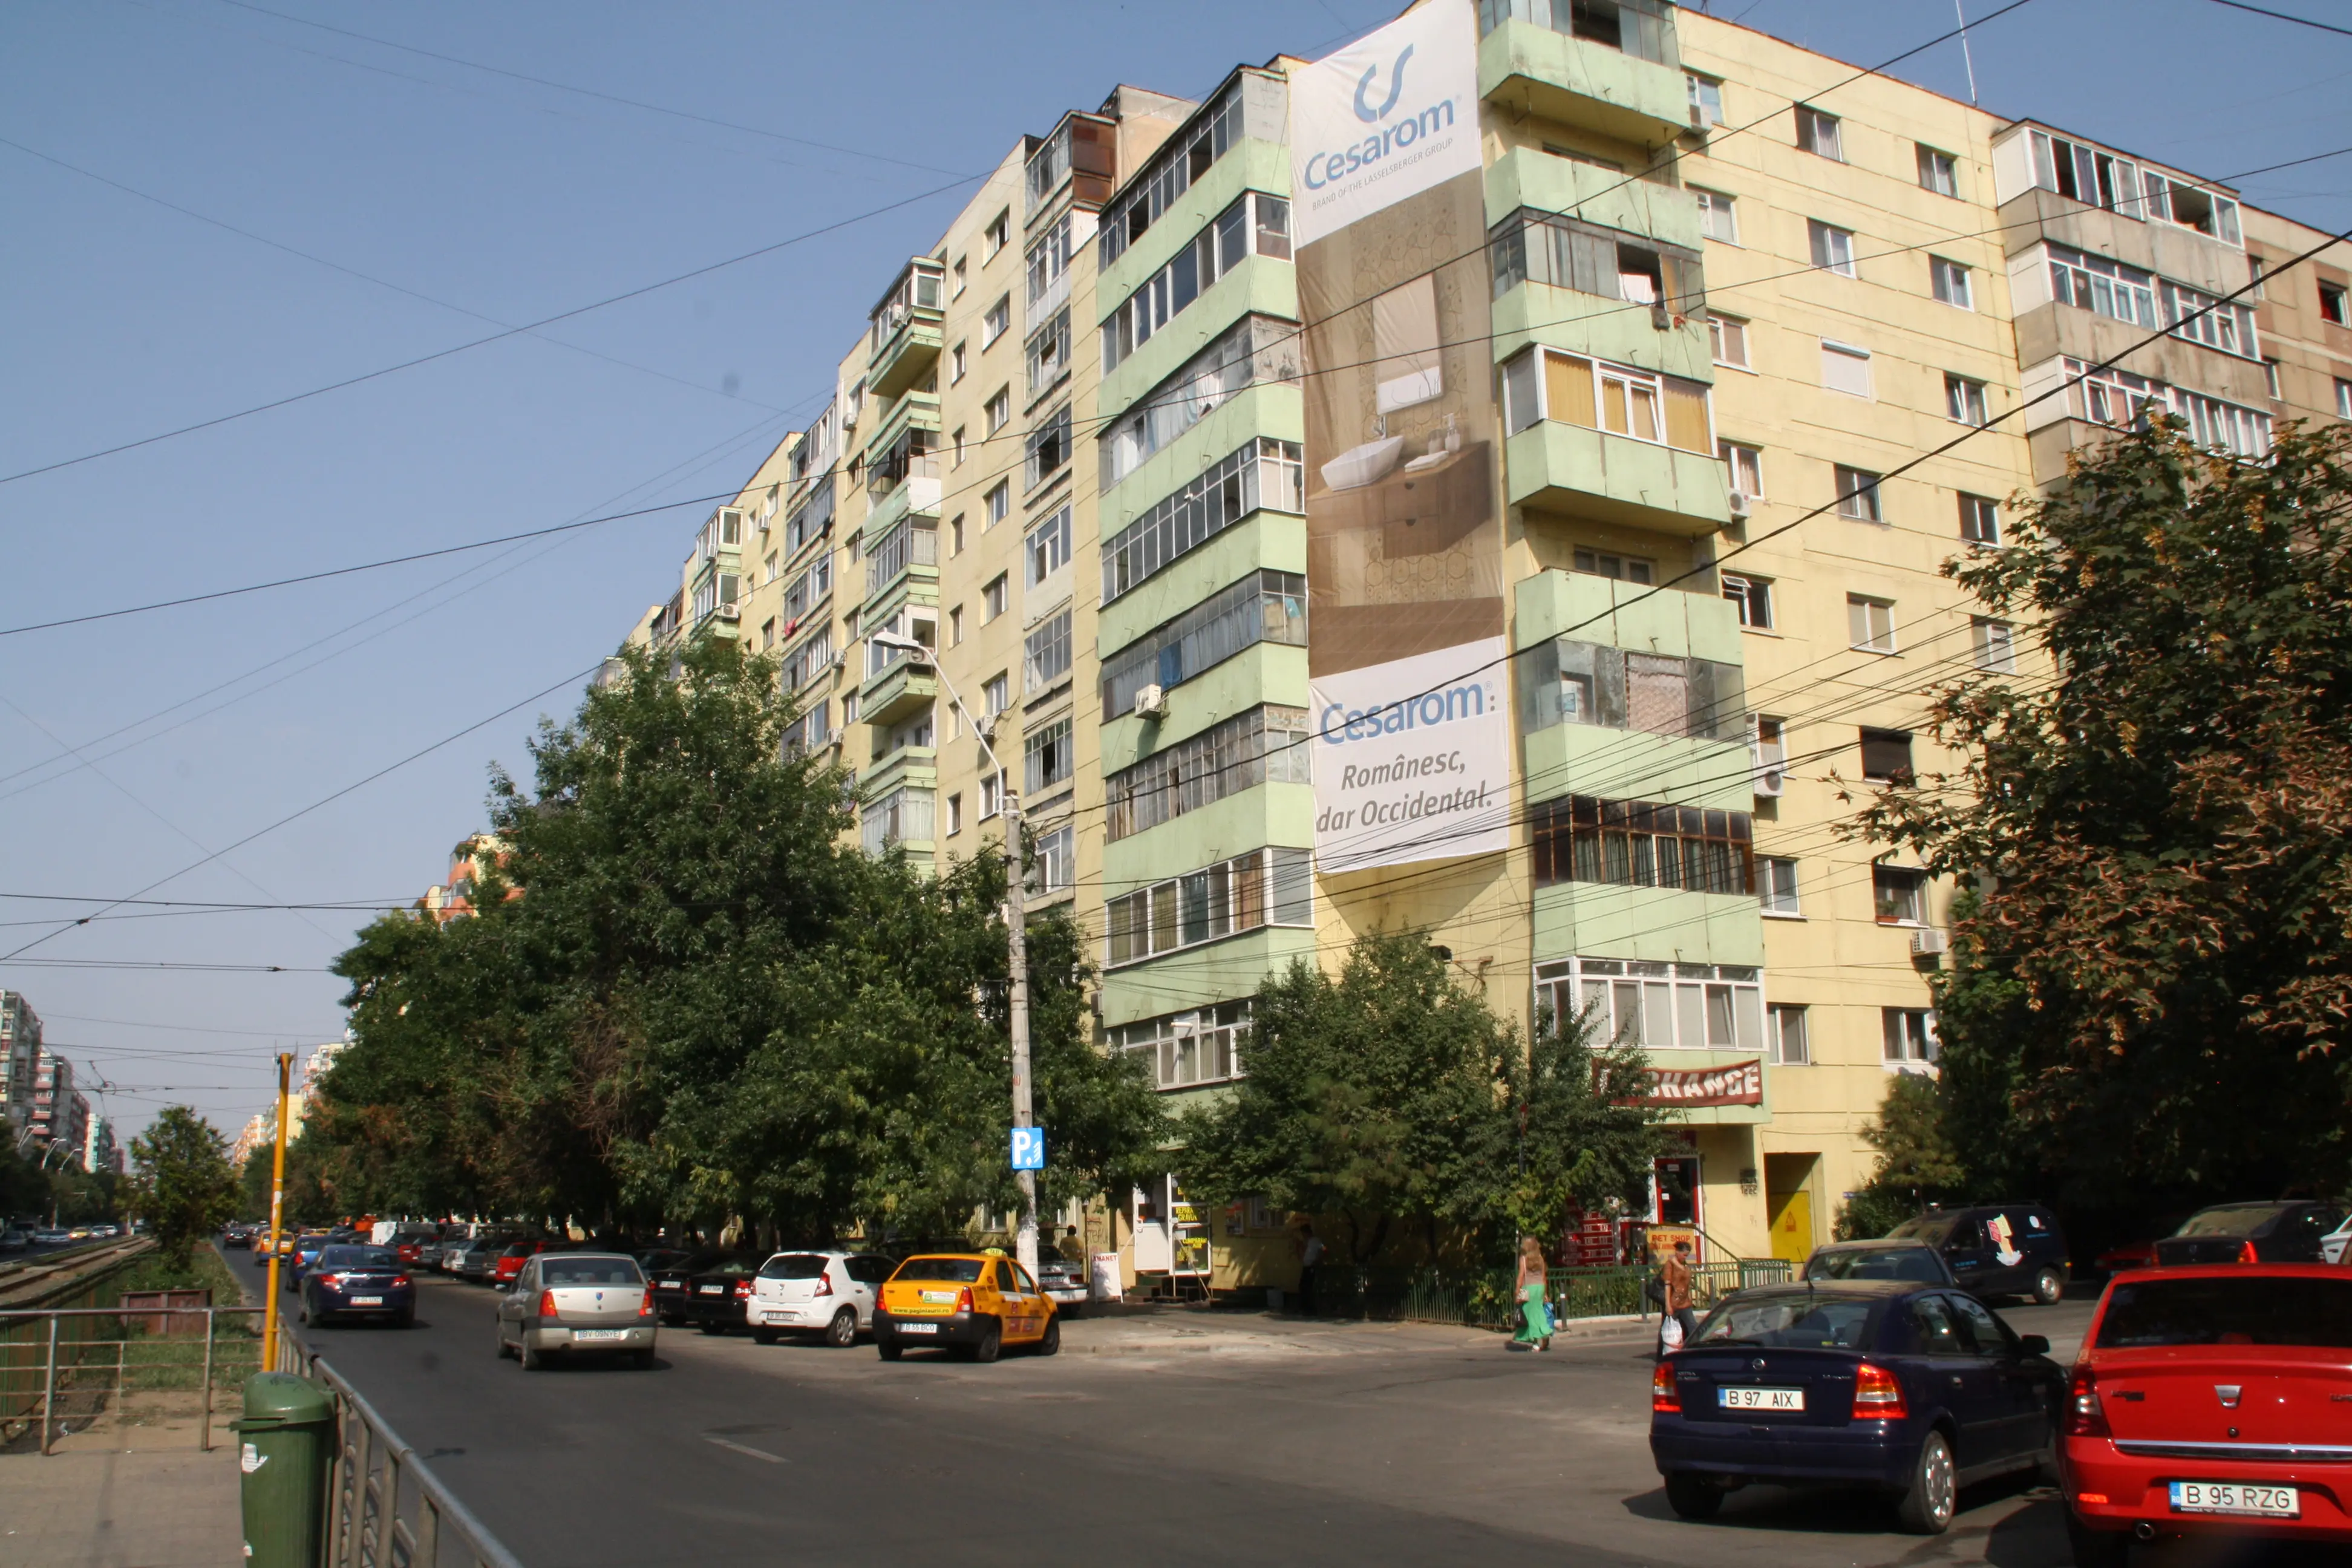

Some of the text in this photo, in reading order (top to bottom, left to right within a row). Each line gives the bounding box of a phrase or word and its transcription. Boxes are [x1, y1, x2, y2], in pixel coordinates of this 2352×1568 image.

[1304, 99, 1454, 190] Cesarom
[1312, 138, 1453, 211] BRAND OF THE LASSELSBERGER GROUP
[1341, 750, 1466, 791] Românesc,
[1316, 780, 1492, 833] dar Occidental.
[1014, 1131, 1031, 1165] P
[1670, 1234, 1690, 1243] SHOP
[1730, 1391, 1794, 1407] B 97 AIX
[2186, 1485, 2290, 1509] B 95 RZG
